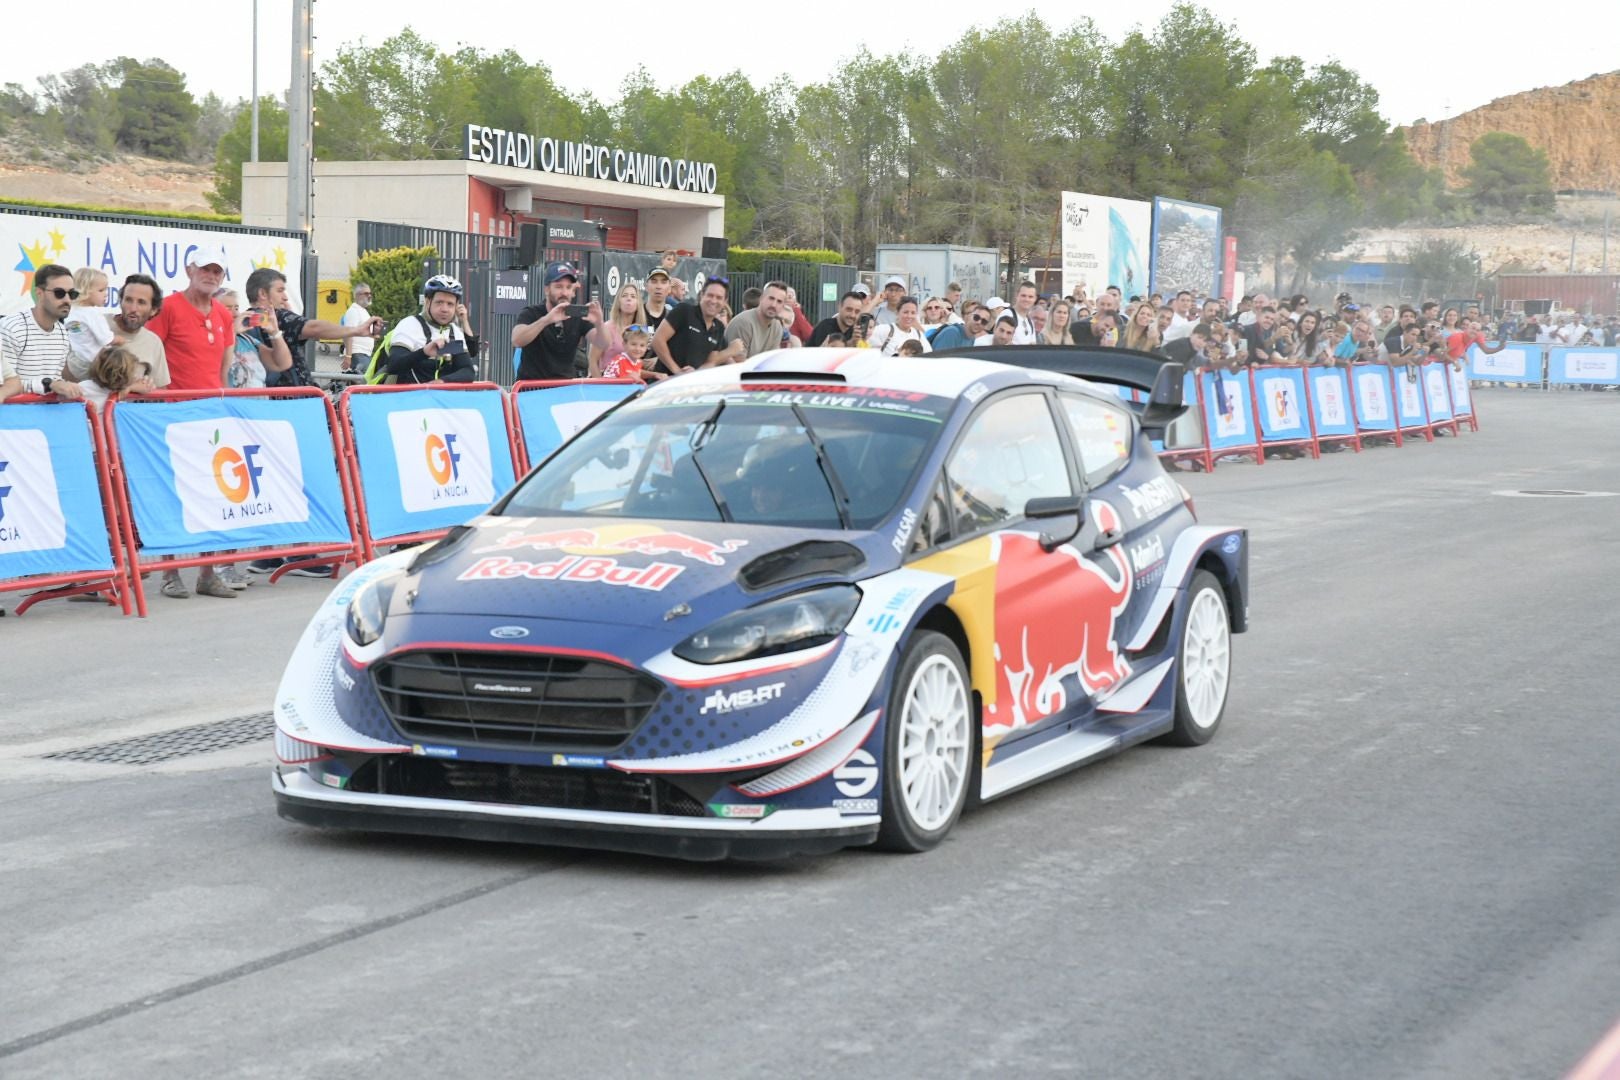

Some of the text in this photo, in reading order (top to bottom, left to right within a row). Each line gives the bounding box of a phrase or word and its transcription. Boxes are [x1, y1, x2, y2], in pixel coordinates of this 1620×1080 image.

[467, 123, 717, 194] ESTADI OLIMPIC CAMILO CANO
[549, 227, 575, 239] ENTRADA
[495, 285, 528, 301] ENTRADA
[766, 393, 804, 405] ALL
[809, 395, 858, 408] LIVE
[211, 444, 265, 504] GF
[424, 432, 462, 487] GF
[222, 507, 236, 520] LA
[891, 507, 919, 555] PULSAR
[456, 555, 687, 592] Red Bull
